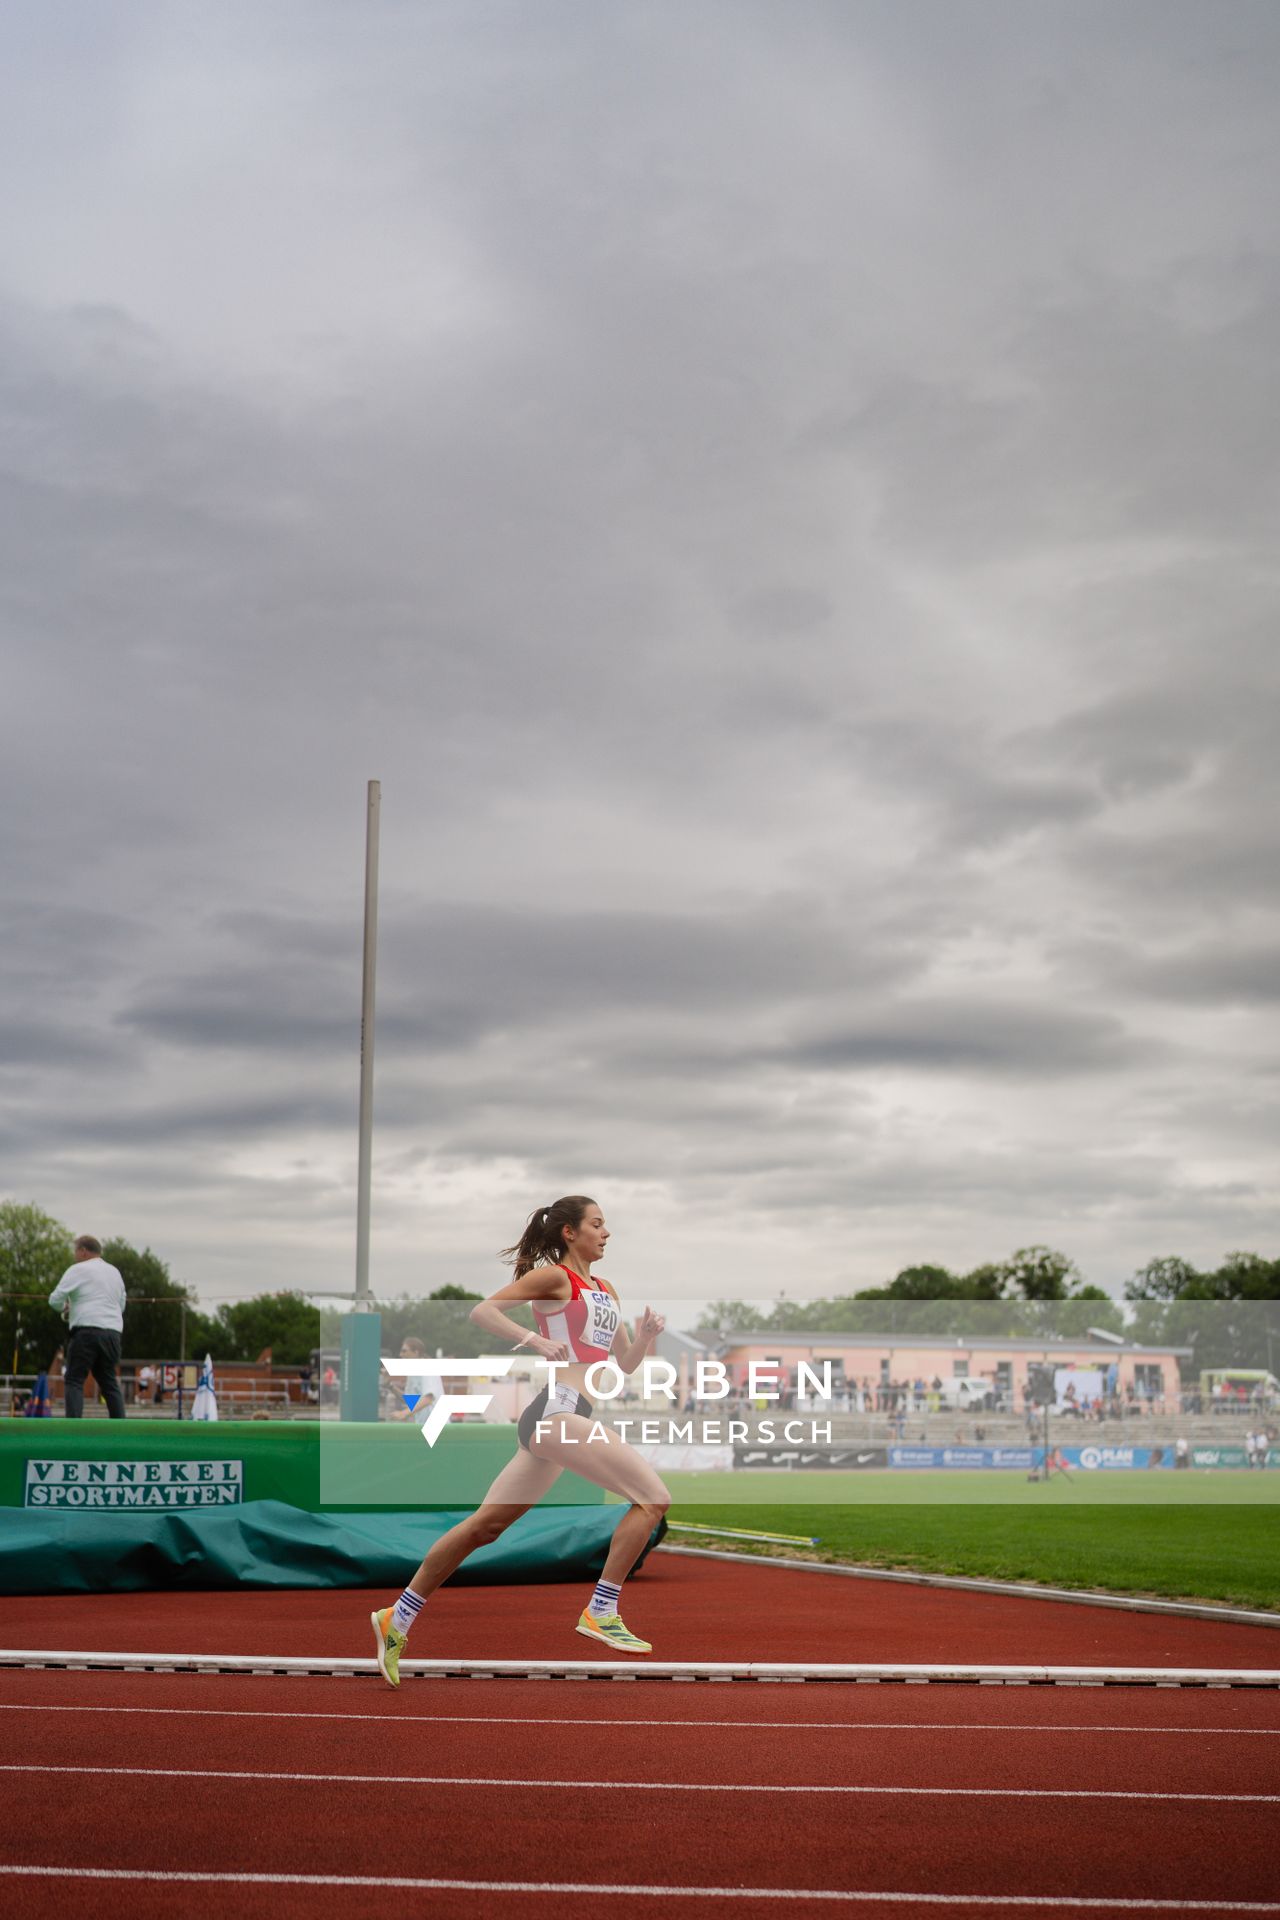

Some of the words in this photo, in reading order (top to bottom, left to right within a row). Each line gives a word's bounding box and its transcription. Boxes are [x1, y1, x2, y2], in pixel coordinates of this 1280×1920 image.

[592, 1292, 611, 1308] GLS
[593, 1305, 617, 1332] 520
[165, 1365, 176, 1384] 5
[34, 1463, 237, 1482] VENNEKEL
[31, 1485, 237, 1506] SPORTMATTEN
